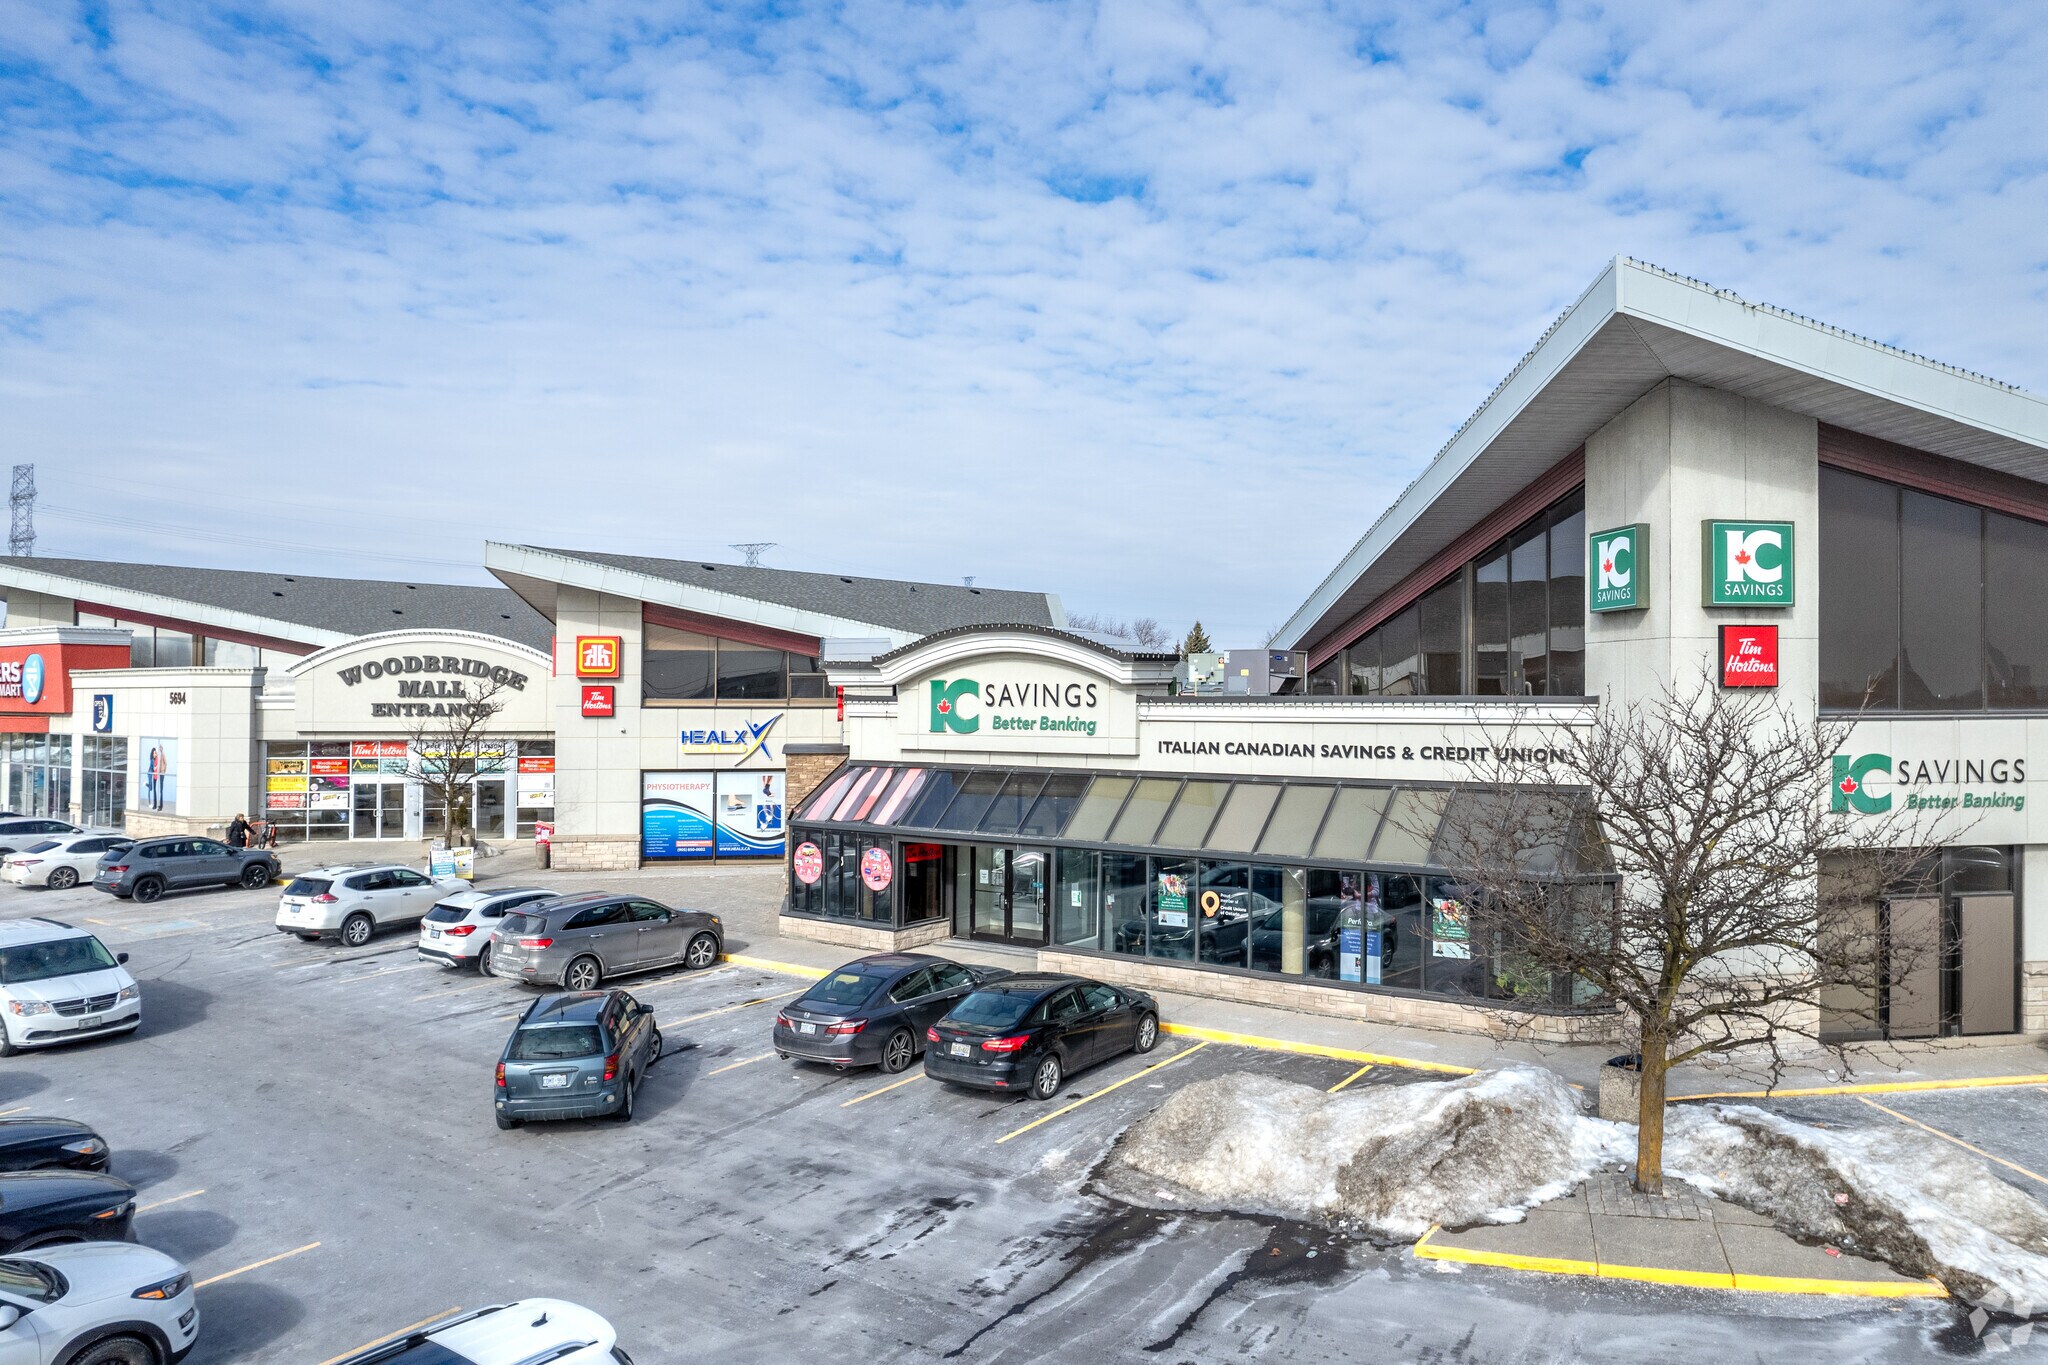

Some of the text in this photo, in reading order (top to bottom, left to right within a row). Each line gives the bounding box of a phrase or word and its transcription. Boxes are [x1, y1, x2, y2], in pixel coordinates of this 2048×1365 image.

[1598, 587, 1631, 603] SAVINGS
[1725, 584, 1783, 596] SAVINGS
[1739, 638, 1762, 655] Tim
[0, 661, 21, 683] RS
[1726, 655, 1775, 673] Hortons
[337, 655, 529, 692] WOODBRIDGE
[398, 680, 467, 699] MALL
[590, 691, 605, 701] Tim
[985, 683, 1098, 708] SAVINGS
[169, 692, 187, 705] 5694
[583, 700, 611, 710] Hortons
[371, 702, 493, 718] ENTRANCE
[992, 715, 1097, 736] Better Banking
[681, 730, 747, 745] HEALX
[354, 744, 371, 755] Tim
[1158, 741, 1566, 763] ITALIAN CANADIAN SAVINGS & CREDIT UNION
[1898, 758, 2025, 785] SAVINGS
[646, 783, 711, 791] PHYSIOTHERAPY
[1908, 791, 2025, 812] Better Banking
